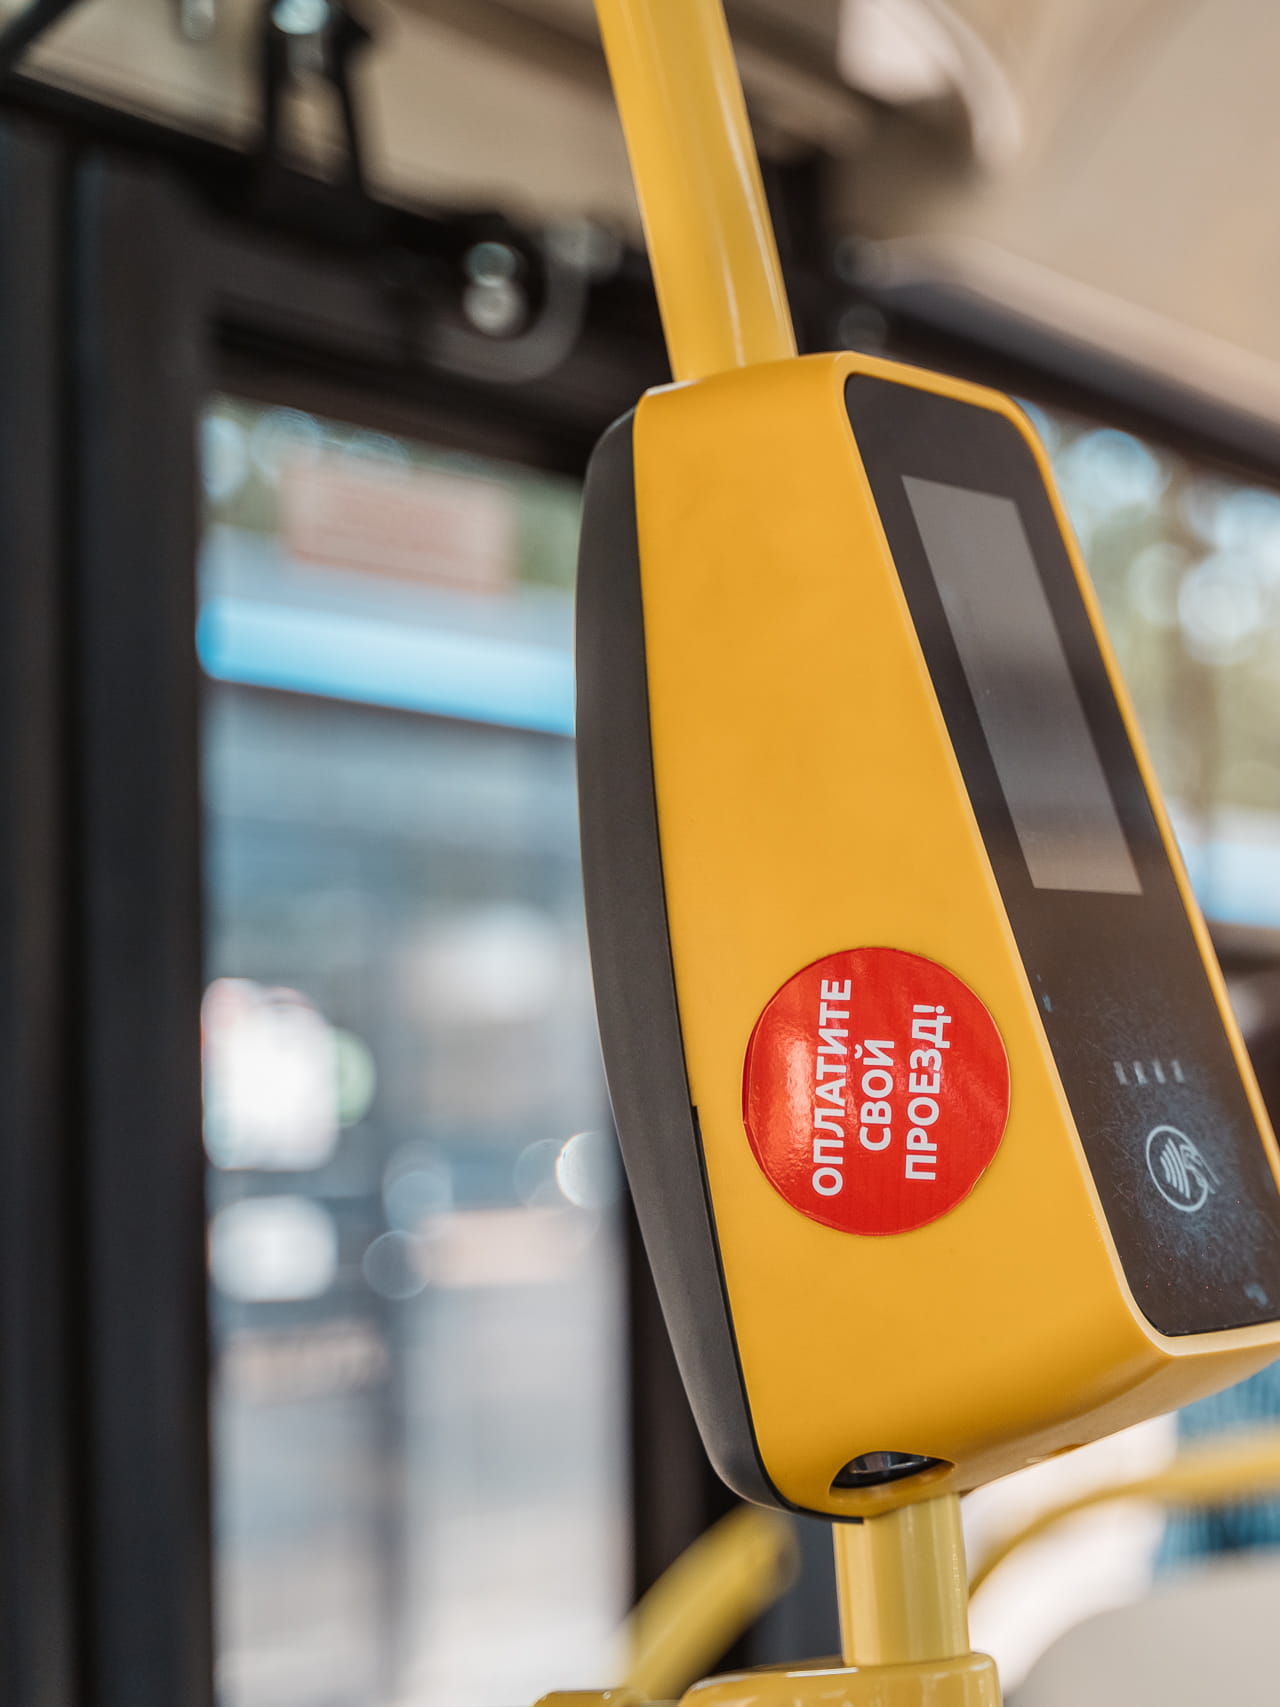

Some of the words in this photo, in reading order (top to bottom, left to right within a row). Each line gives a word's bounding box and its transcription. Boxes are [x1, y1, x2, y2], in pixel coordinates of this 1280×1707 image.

[812, 979, 852, 1196] ОПЛАТИТЕ
[854, 1039, 895, 1151] СВОЙ
[905, 1004, 952, 1180] ПРОЕЗД!
